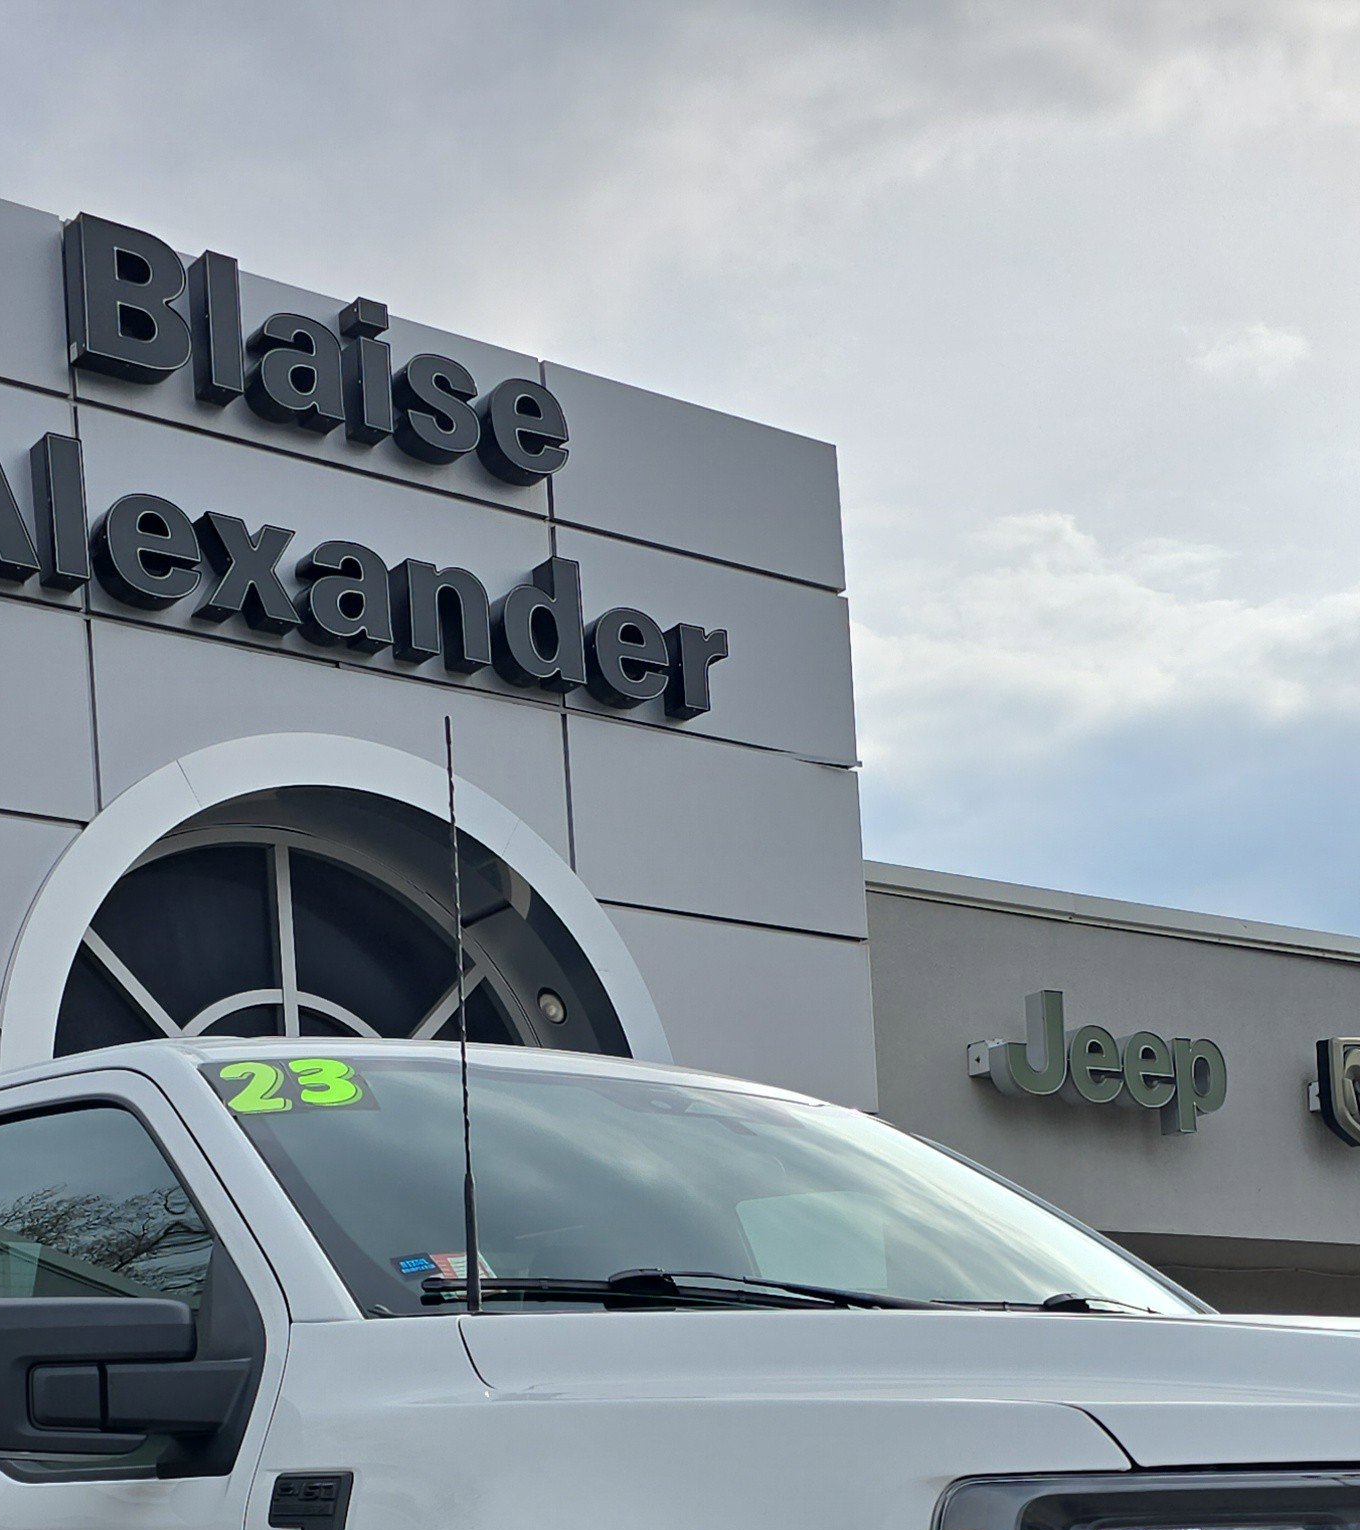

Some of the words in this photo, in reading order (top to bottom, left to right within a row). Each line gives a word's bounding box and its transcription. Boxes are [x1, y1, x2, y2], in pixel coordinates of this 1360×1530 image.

[63, 211, 570, 488] Blaise
[219, 1058, 364, 1115] 23
[989, 989, 1228, 1136] Jeep
